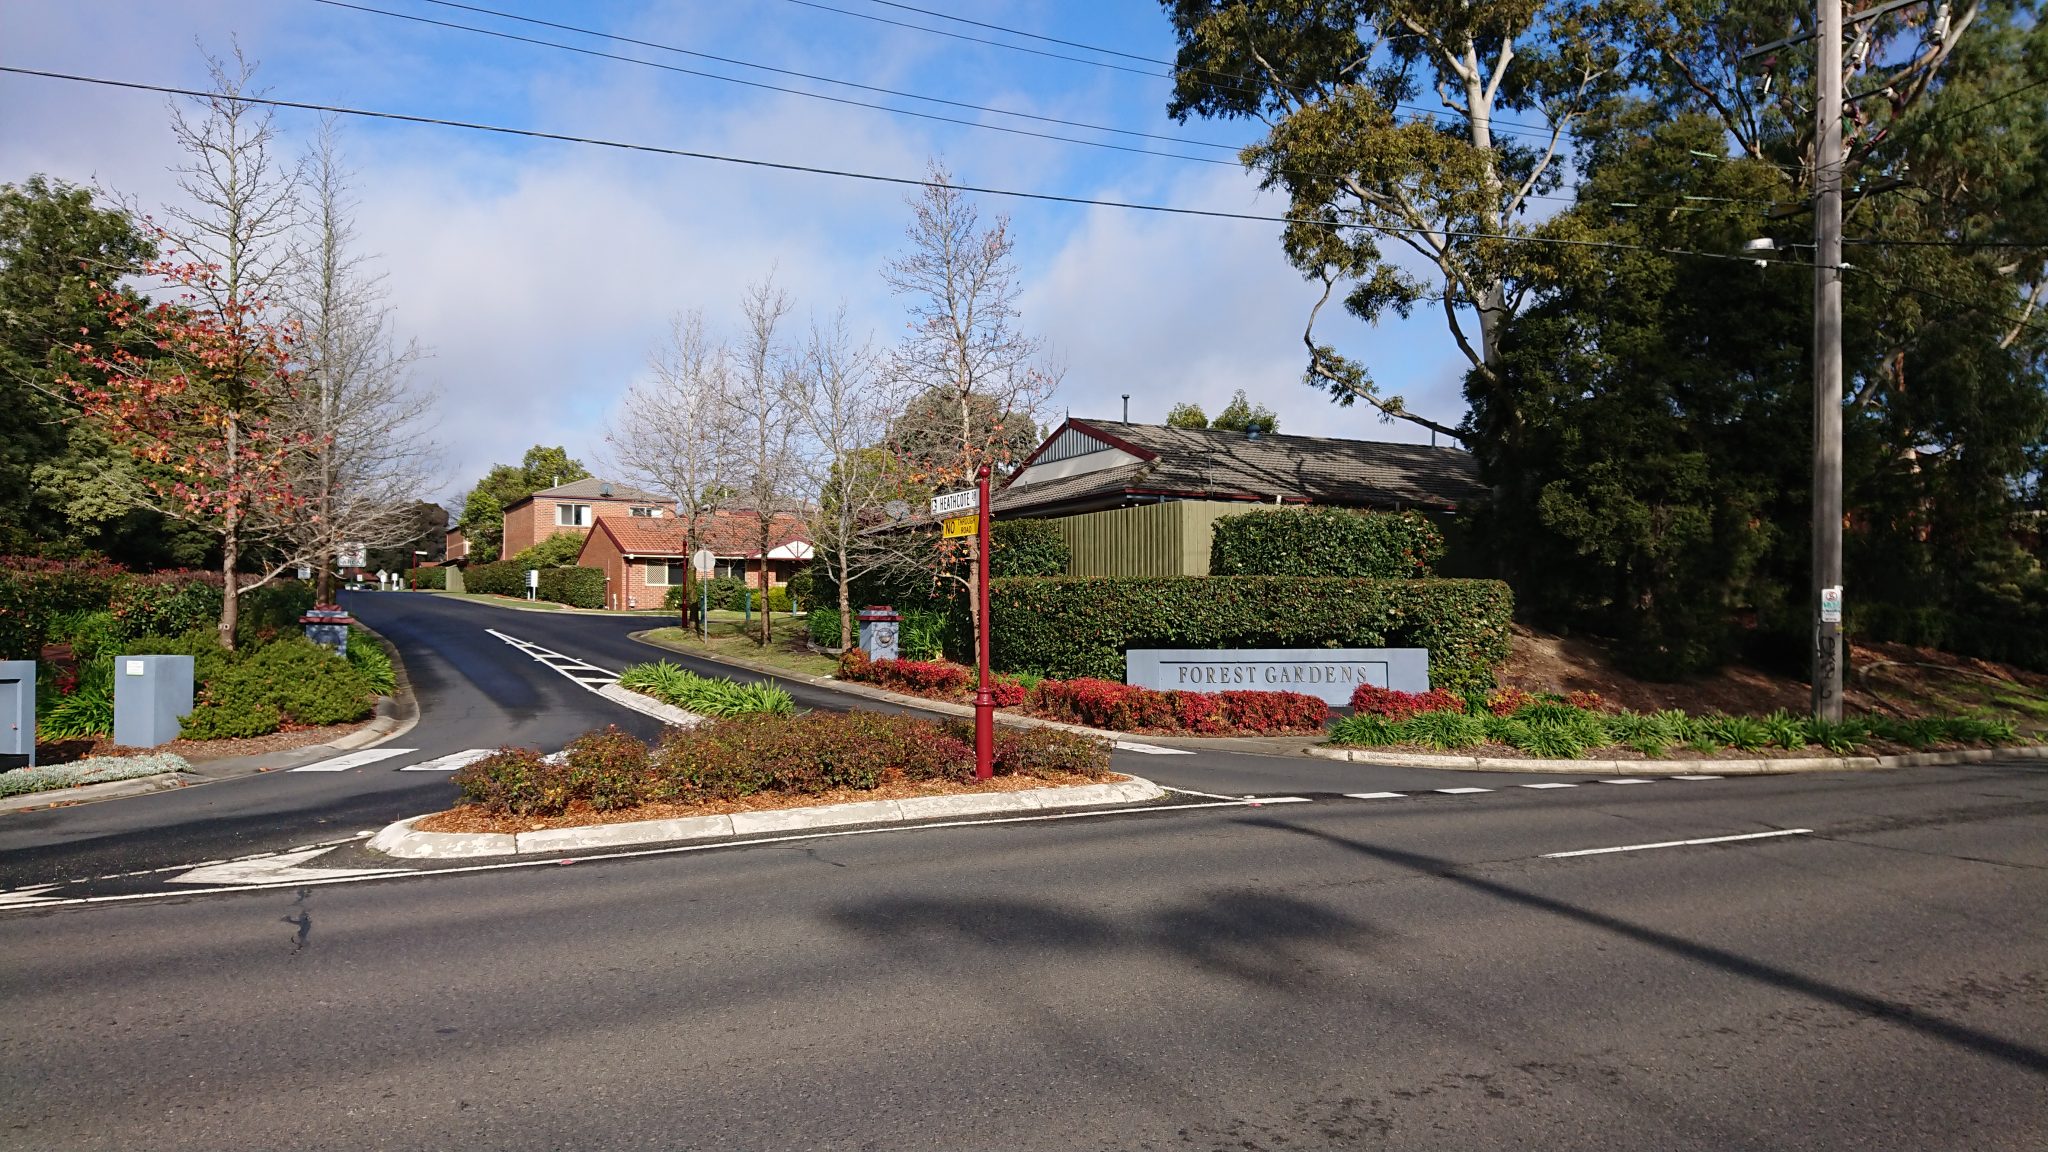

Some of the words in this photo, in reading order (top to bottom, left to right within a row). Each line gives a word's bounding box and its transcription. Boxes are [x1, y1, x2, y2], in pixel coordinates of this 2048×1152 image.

[939, 492, 970, 511] HEATHCOTE
[945, 521, 956, 535] NO
[957, 516, 976, 526] THROUGH
[960, 525, 972, 534] ROAD
[1178, 665, 1257, 684] FOREST
[1264, 665, 1367, 684] GARDENS
